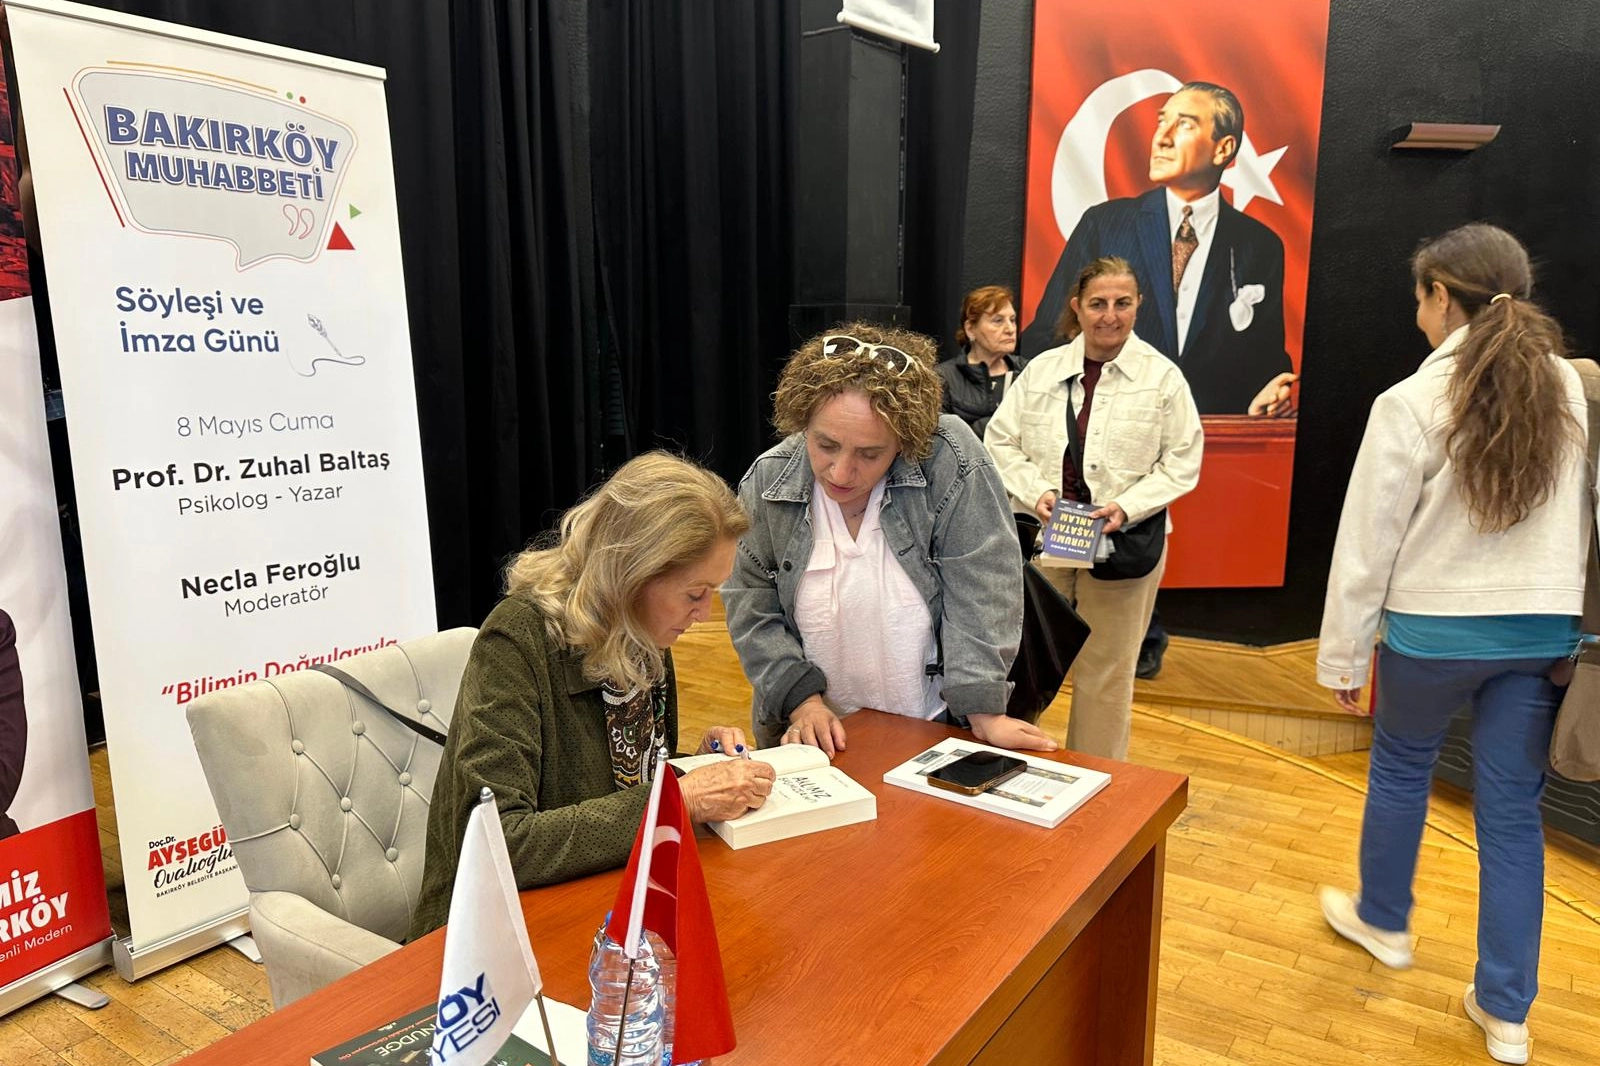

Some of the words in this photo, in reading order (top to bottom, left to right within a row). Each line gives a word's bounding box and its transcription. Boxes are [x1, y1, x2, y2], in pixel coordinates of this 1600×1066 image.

[105, 105, 339, 171] BAKIRKÖY
[126, 151, 325, 200] MUHABBETİ
[116, 286, 223, 320] Söyleşi
[231, 298, 264, 315] ve
[120, 321, 196, 353] İmza
[204, 329, 280, 353] Günü
[177, 416, 191, 436] 8
[199, 415, 263, 438] Mayıs
[269, 412, 334, 432] Cuma
[112, 463, 184, 490] Prof.
[193, 462, 231, 484] Dr.
[239, 454, 311, 480] Zuhal
[319, 450, 391, 472] Baltaş
[178, 492, 269, 515] Psikolog
[288, 484, 343, 503] Yazar
[1051, 522, 1096, 538] YAŞATAN
[1060, 513, 1094, 527] ANLAM
[1050, 533, 1092, 549] KURUMU
[181, 569, 258, 599] Necla
[266, 553, 361, 584] Feroğlu
[224, 586, 329, 617] Moderatör
[148, 824, 227, 871] AYŞEGÜ
[154, 844, 233, 888] Ovalıoğlu
[156, 884, 186, 898] BAKIRKÖY
[187, 873, 214, 887] BELEDİYE
[24, 924, 73, 951] Modern
[374, 1023, 437, 1057] NUDGE
